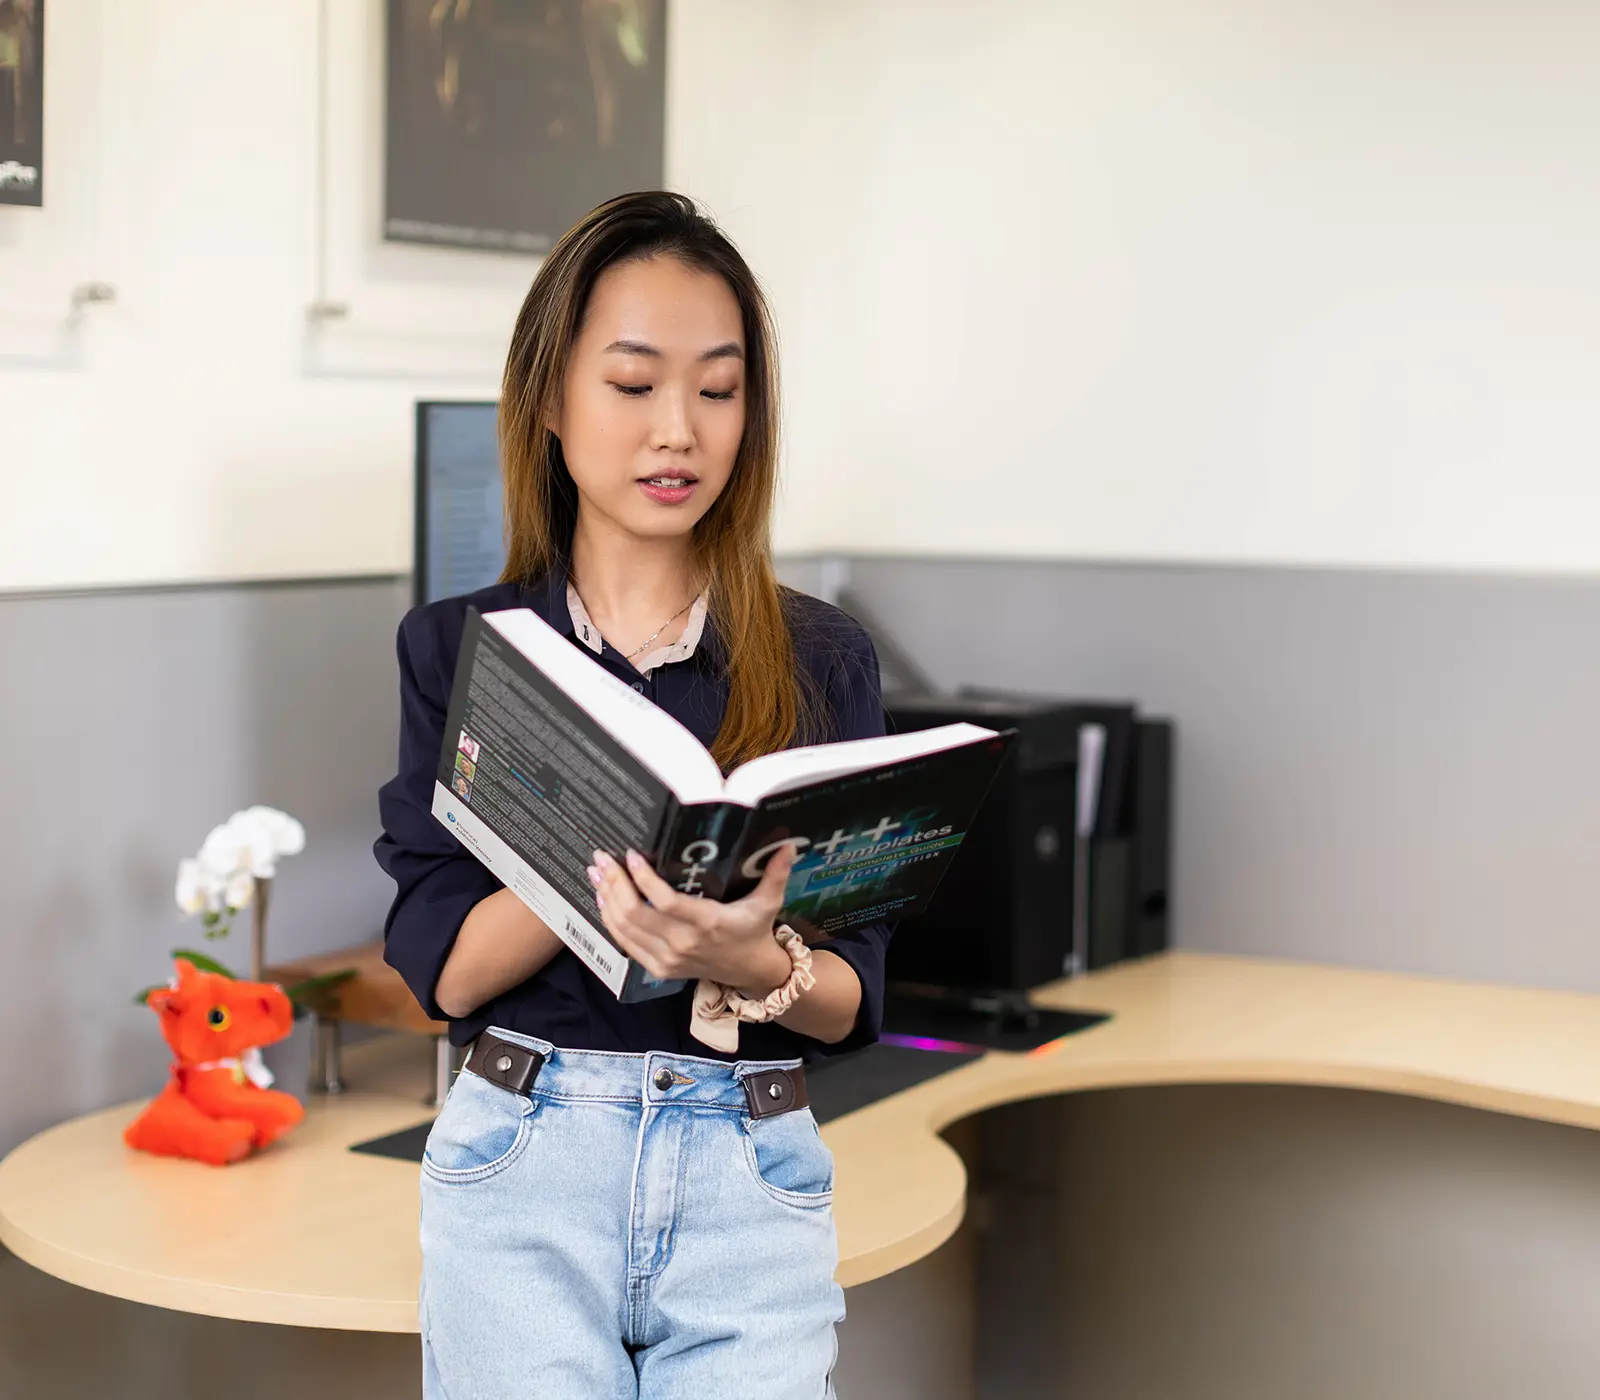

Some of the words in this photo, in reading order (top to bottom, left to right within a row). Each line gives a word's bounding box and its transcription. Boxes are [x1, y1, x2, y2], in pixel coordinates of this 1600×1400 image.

[741, 816, 902, 879] C++
[821, 867, 844, 878] The
[847, 851, 906, 871] Complete
[910, 840, 946, 853] Guide
[822, 825, 953, 865] Templates
[677, 840, 719, 892] C++
[844, 864, 888, 881] SECOND
[893, 851, 941, 868] EDITION
